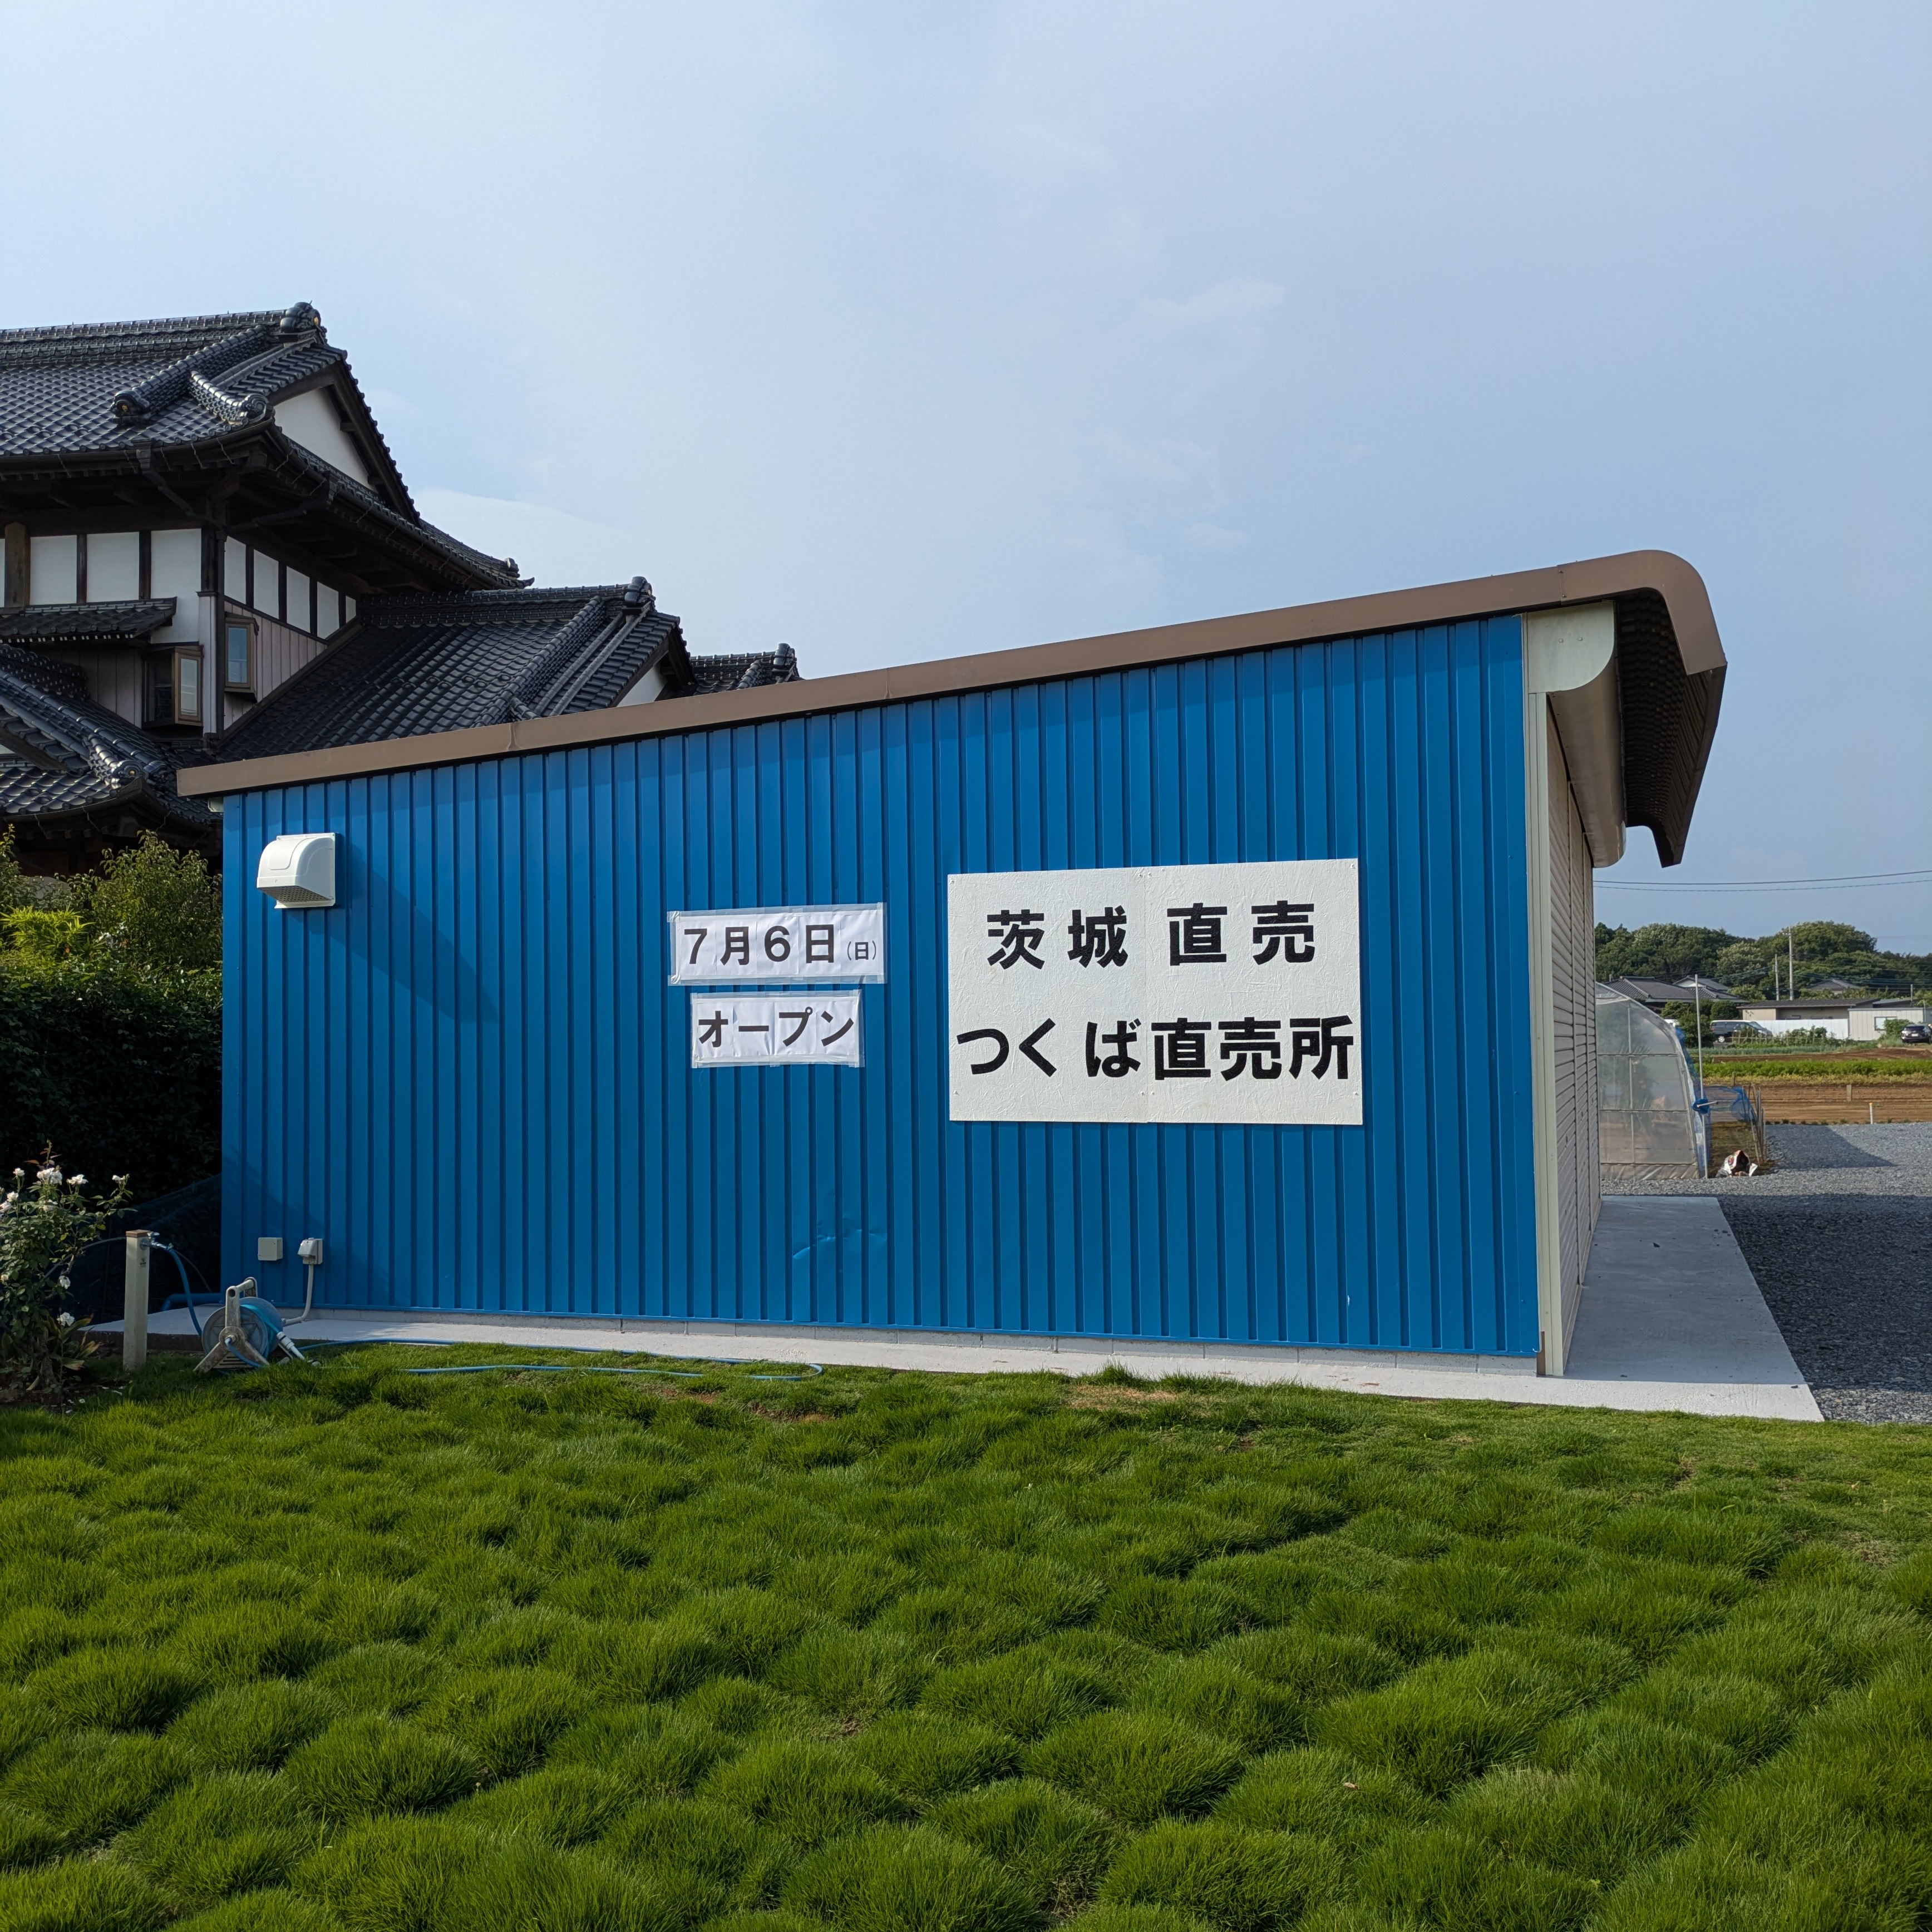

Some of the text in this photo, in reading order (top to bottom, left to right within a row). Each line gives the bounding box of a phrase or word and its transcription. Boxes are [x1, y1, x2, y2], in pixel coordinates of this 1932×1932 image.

[987, 900, 1315, 970] 茨城直売
[698, 1007, 854, 1048] オープン
[956, 1014, 1354, 1082] つくば直売所
